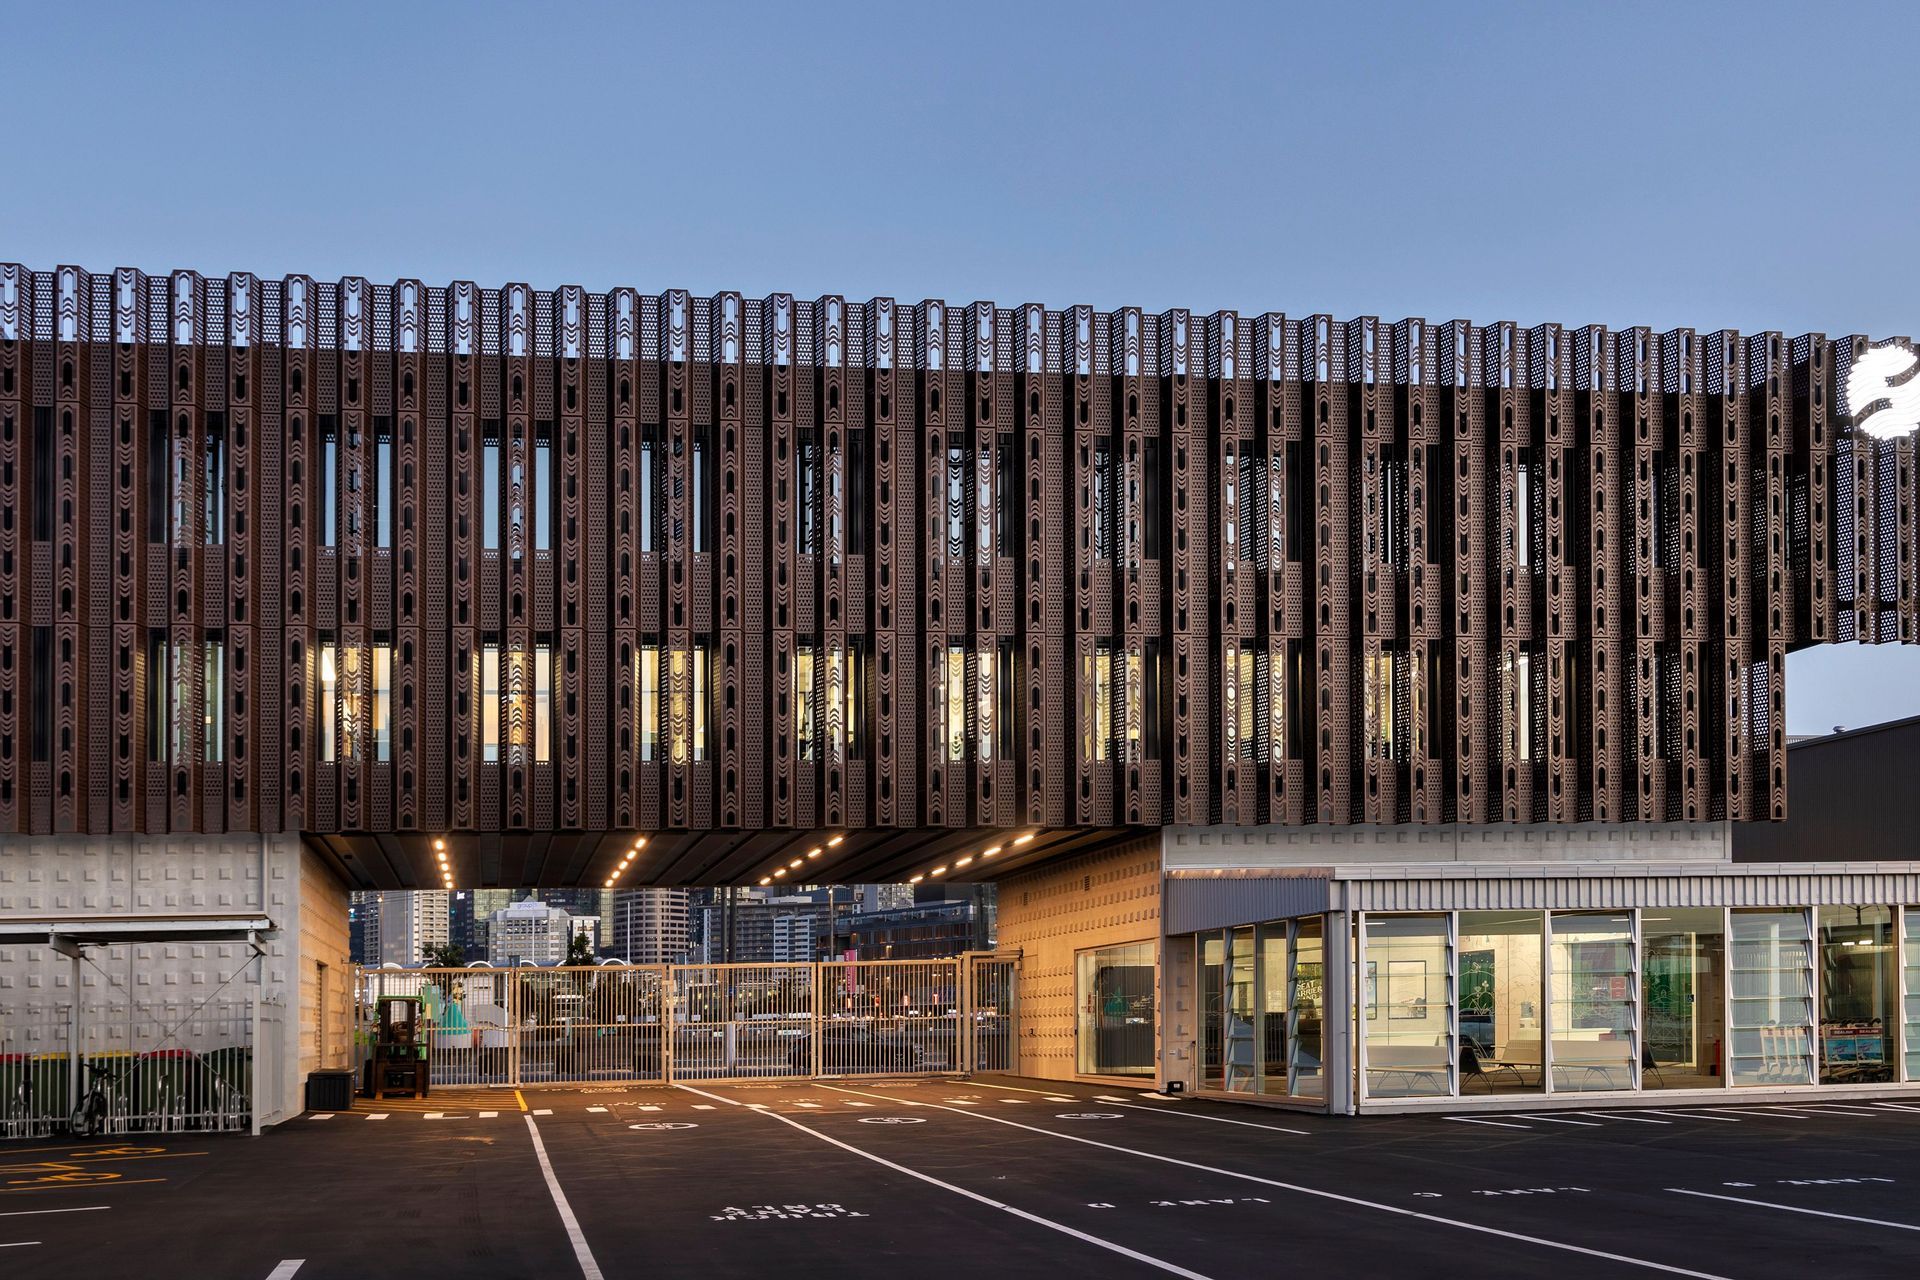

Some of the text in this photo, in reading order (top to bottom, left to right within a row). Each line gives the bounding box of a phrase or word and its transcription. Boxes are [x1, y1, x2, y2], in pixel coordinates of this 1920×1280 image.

[1471, 1187, 1591, 1196] LANE
[1149, 1198, 1271, 1207] LANE
[721, 1203, 841, 1213] ONLY
[724, 1207, 847, 1216] LANE
[709, 1211, 870, 1221] TRUCK
